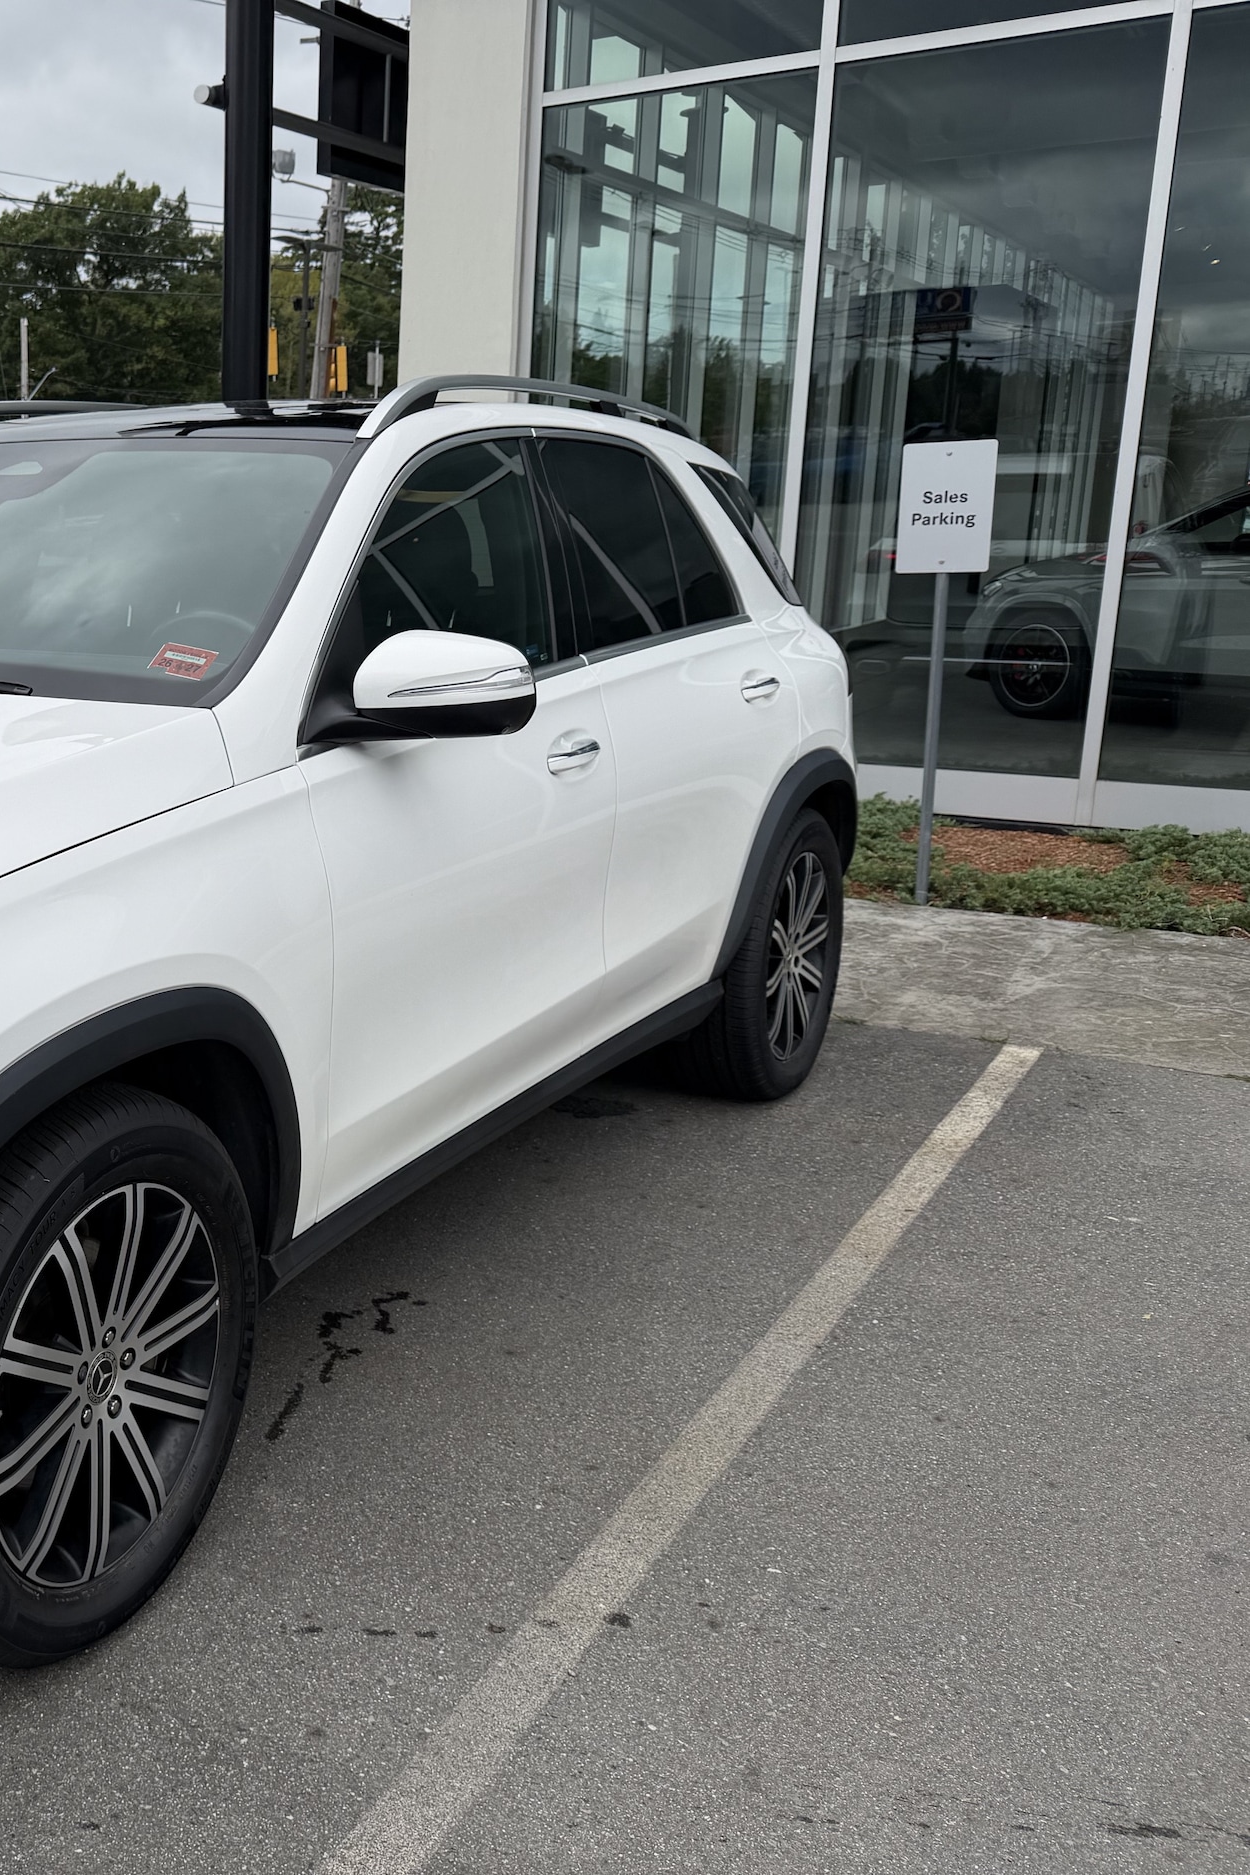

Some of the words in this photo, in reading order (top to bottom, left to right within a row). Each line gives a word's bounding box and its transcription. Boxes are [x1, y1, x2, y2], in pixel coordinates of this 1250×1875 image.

[923, 490, 968, 504] Sales
[912, 512, 976, 528] Parking
[157, 658, 174, 668] 26
[184, 663, 202, 673] 27
[28, 1211, 56, 1255] TOUR
